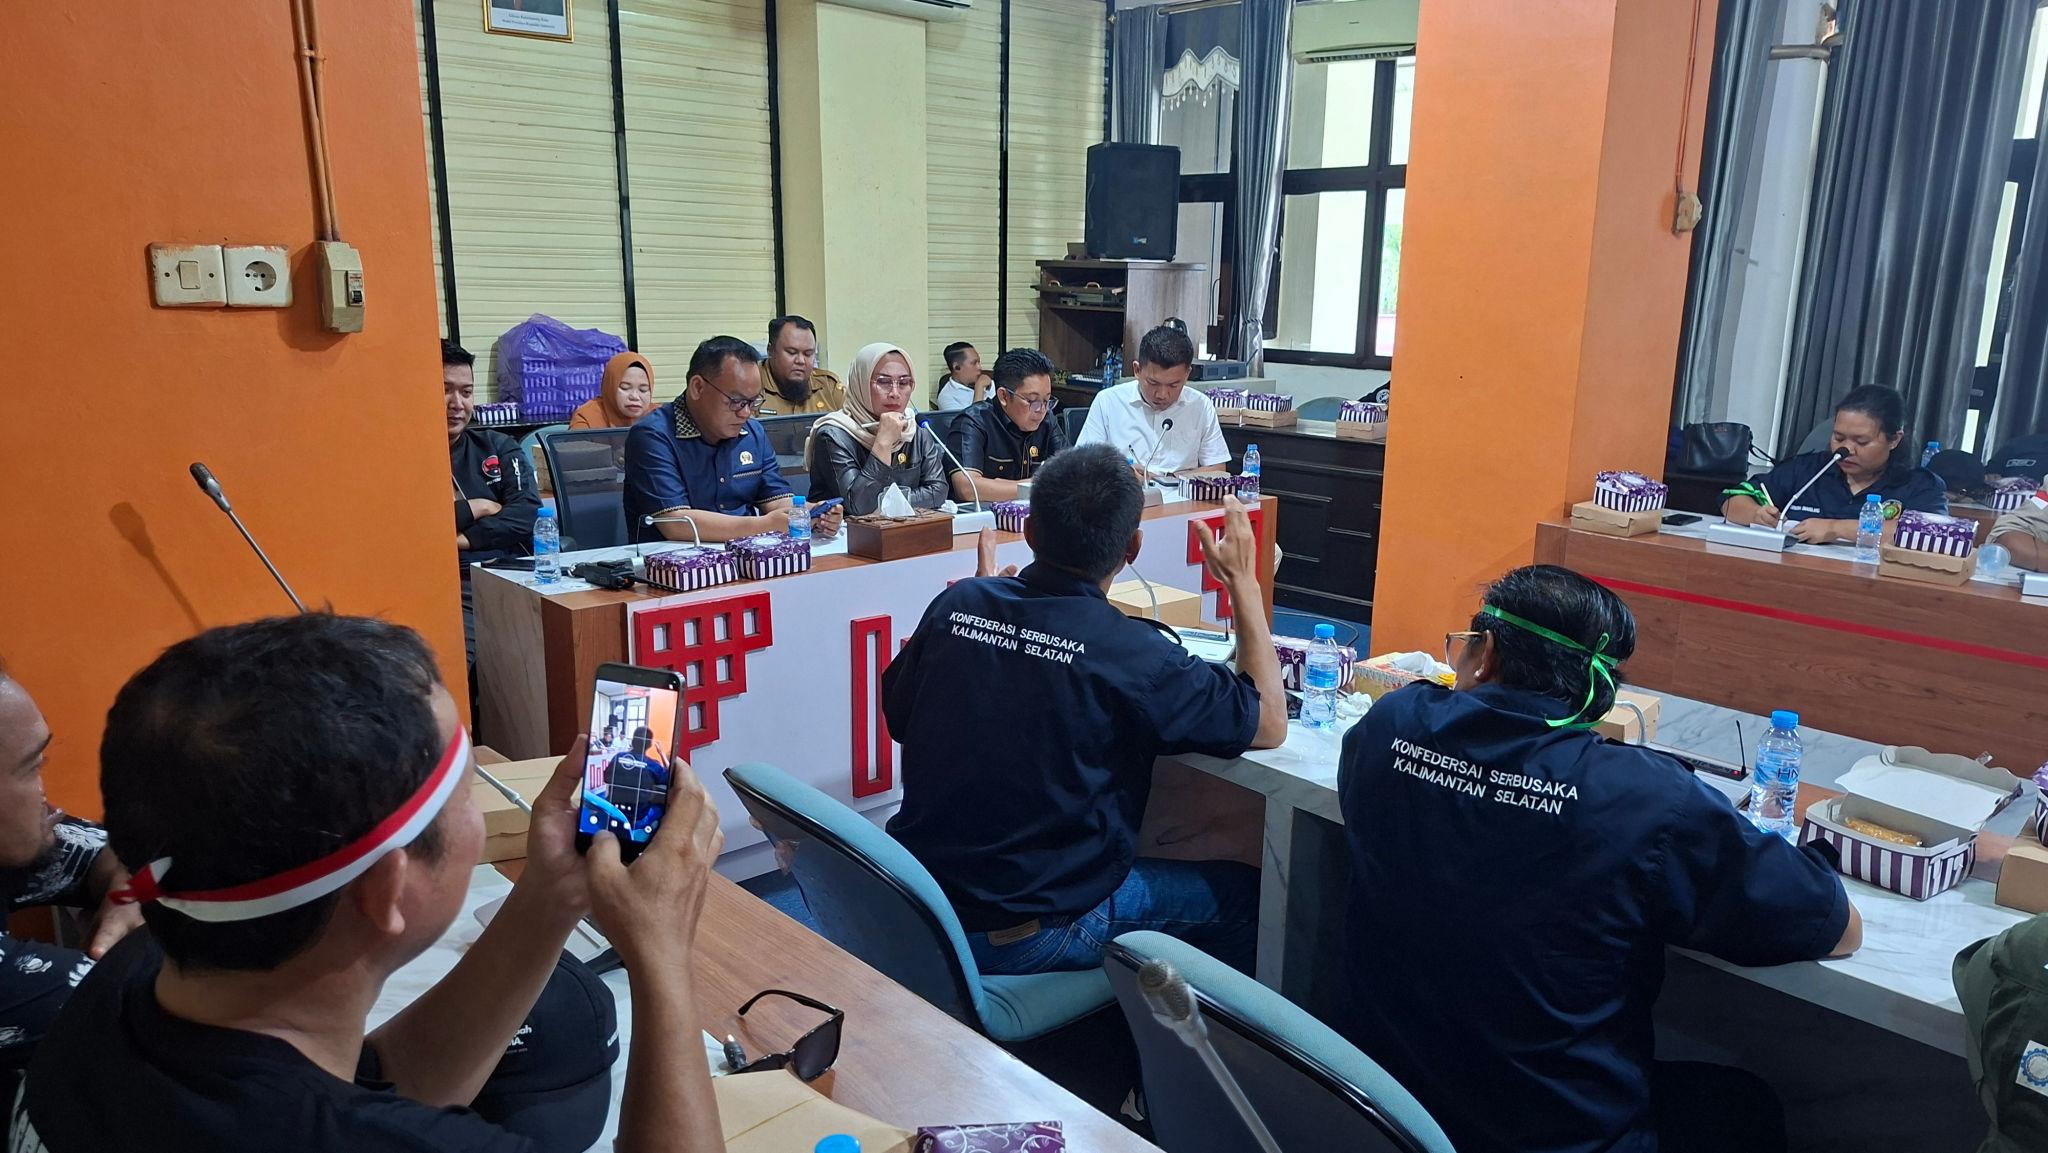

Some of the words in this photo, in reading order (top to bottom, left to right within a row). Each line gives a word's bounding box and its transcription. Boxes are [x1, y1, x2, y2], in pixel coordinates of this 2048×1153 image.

[949, 611, 1016, 635] KONFEDERASI
[1020, 628, 1085, 653] SERBUSAKA
[951, 624, 1018, 650] KALIMANTAN
[1024, 644, 1074, 664] SELATAN
[1391, 738, 1483, 779] KONFEDERSAI
[1489, 770, 1578, 800] SERBUSAKA
[1393, 757, 1486, 798] KALIMANTAN
[1494, 790, 1563, 815] SELATAN
